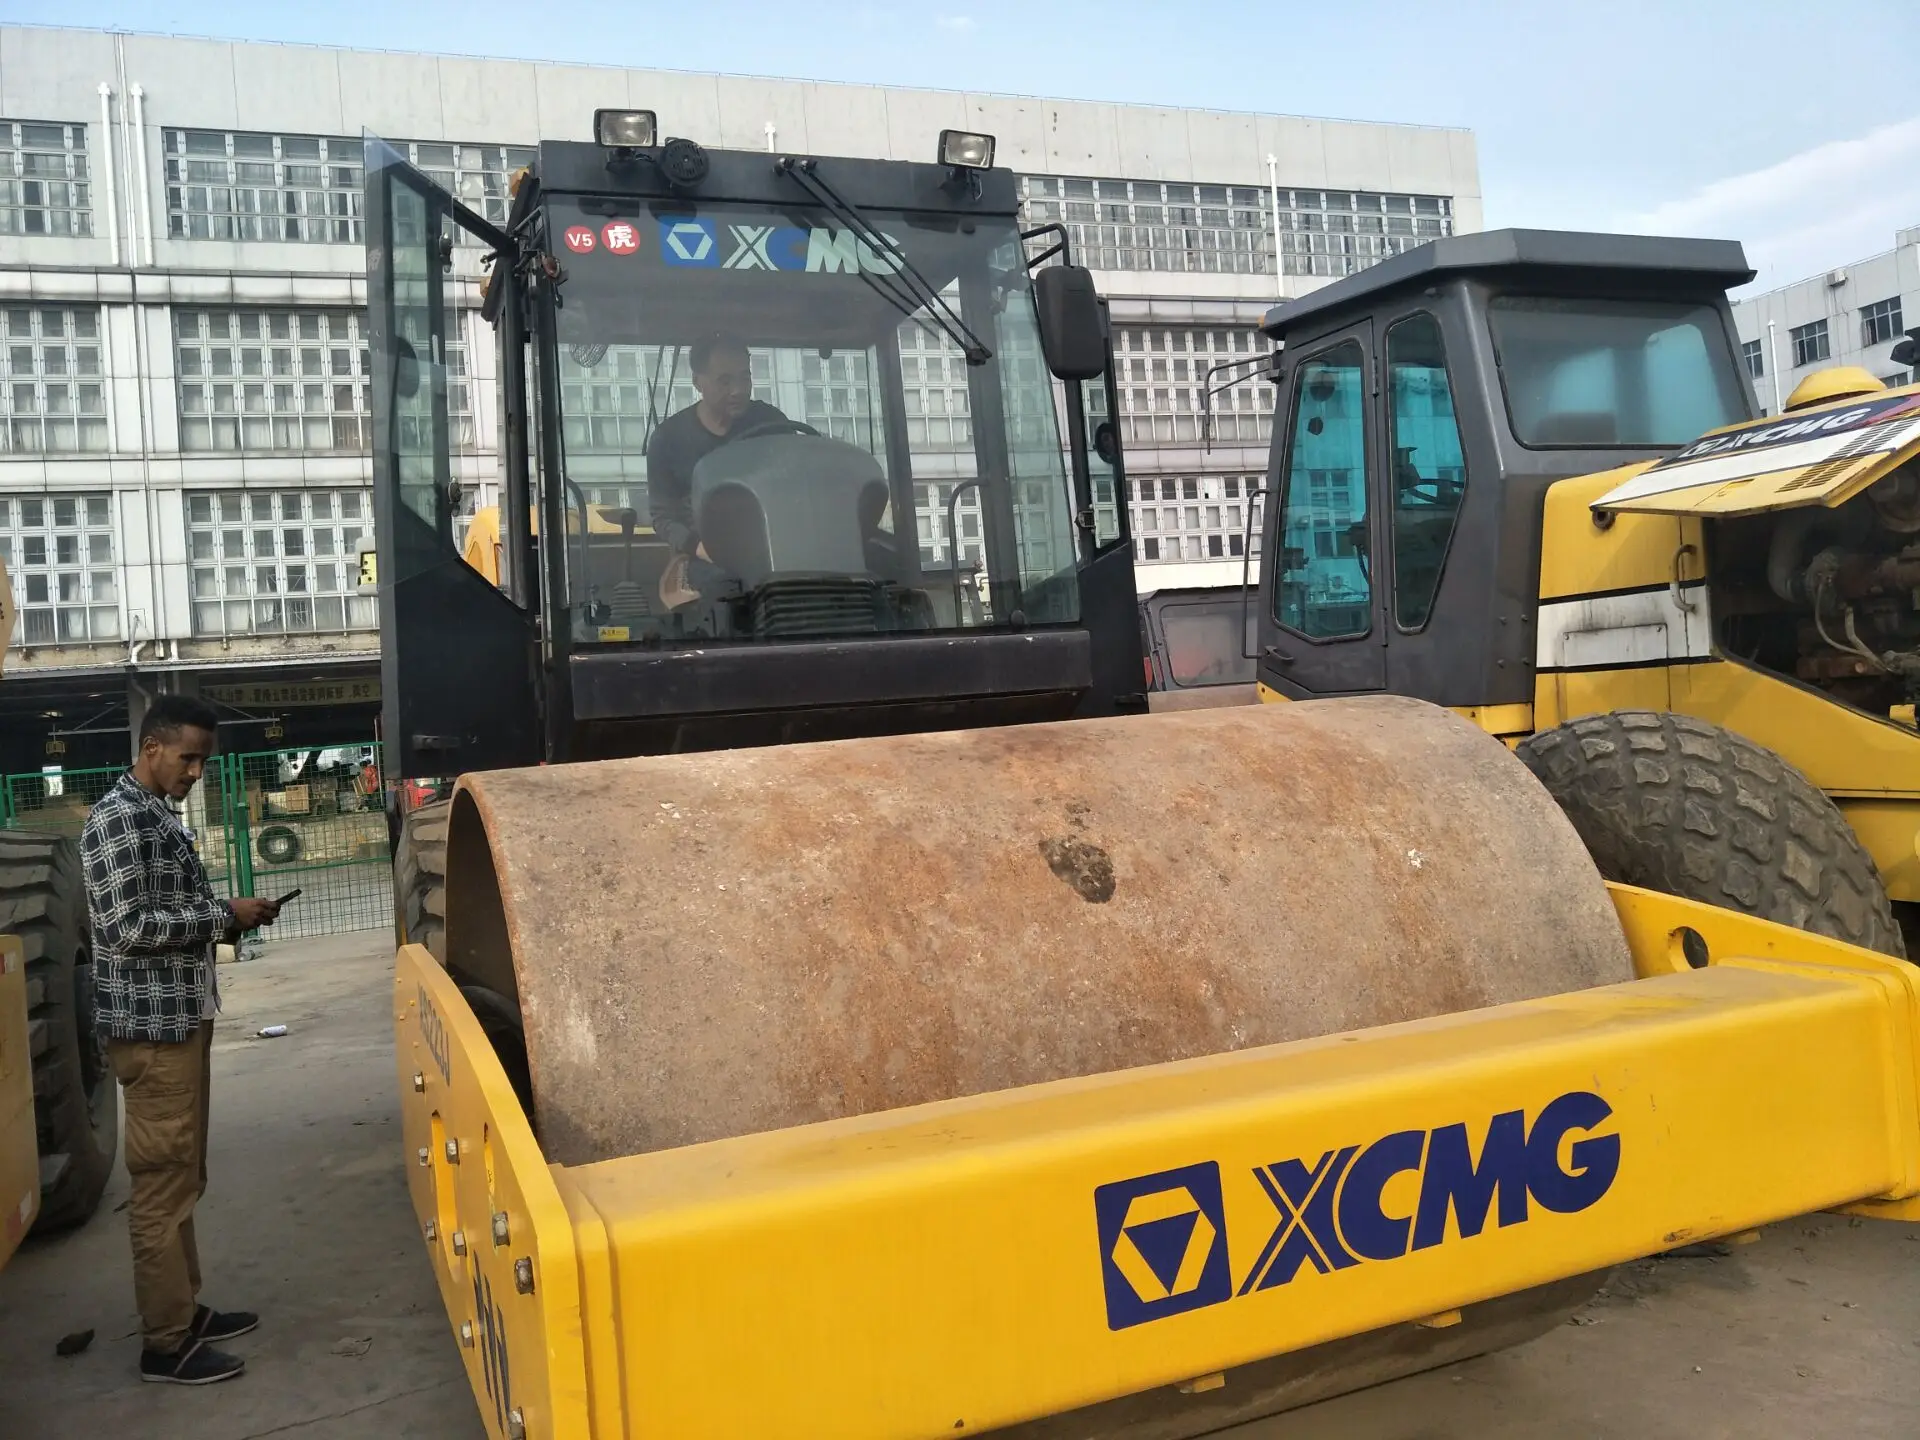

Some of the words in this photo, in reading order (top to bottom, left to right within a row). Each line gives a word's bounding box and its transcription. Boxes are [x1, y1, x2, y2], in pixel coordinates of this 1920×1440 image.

[568, 233, 593, 247] V5
[607, 225, 636, 249] 虎
[722, 224, 906, 276] XCMG
[1720, 407, 1872, 449] XCMG
[1236, 1091, 1621, 1298] XCMG
